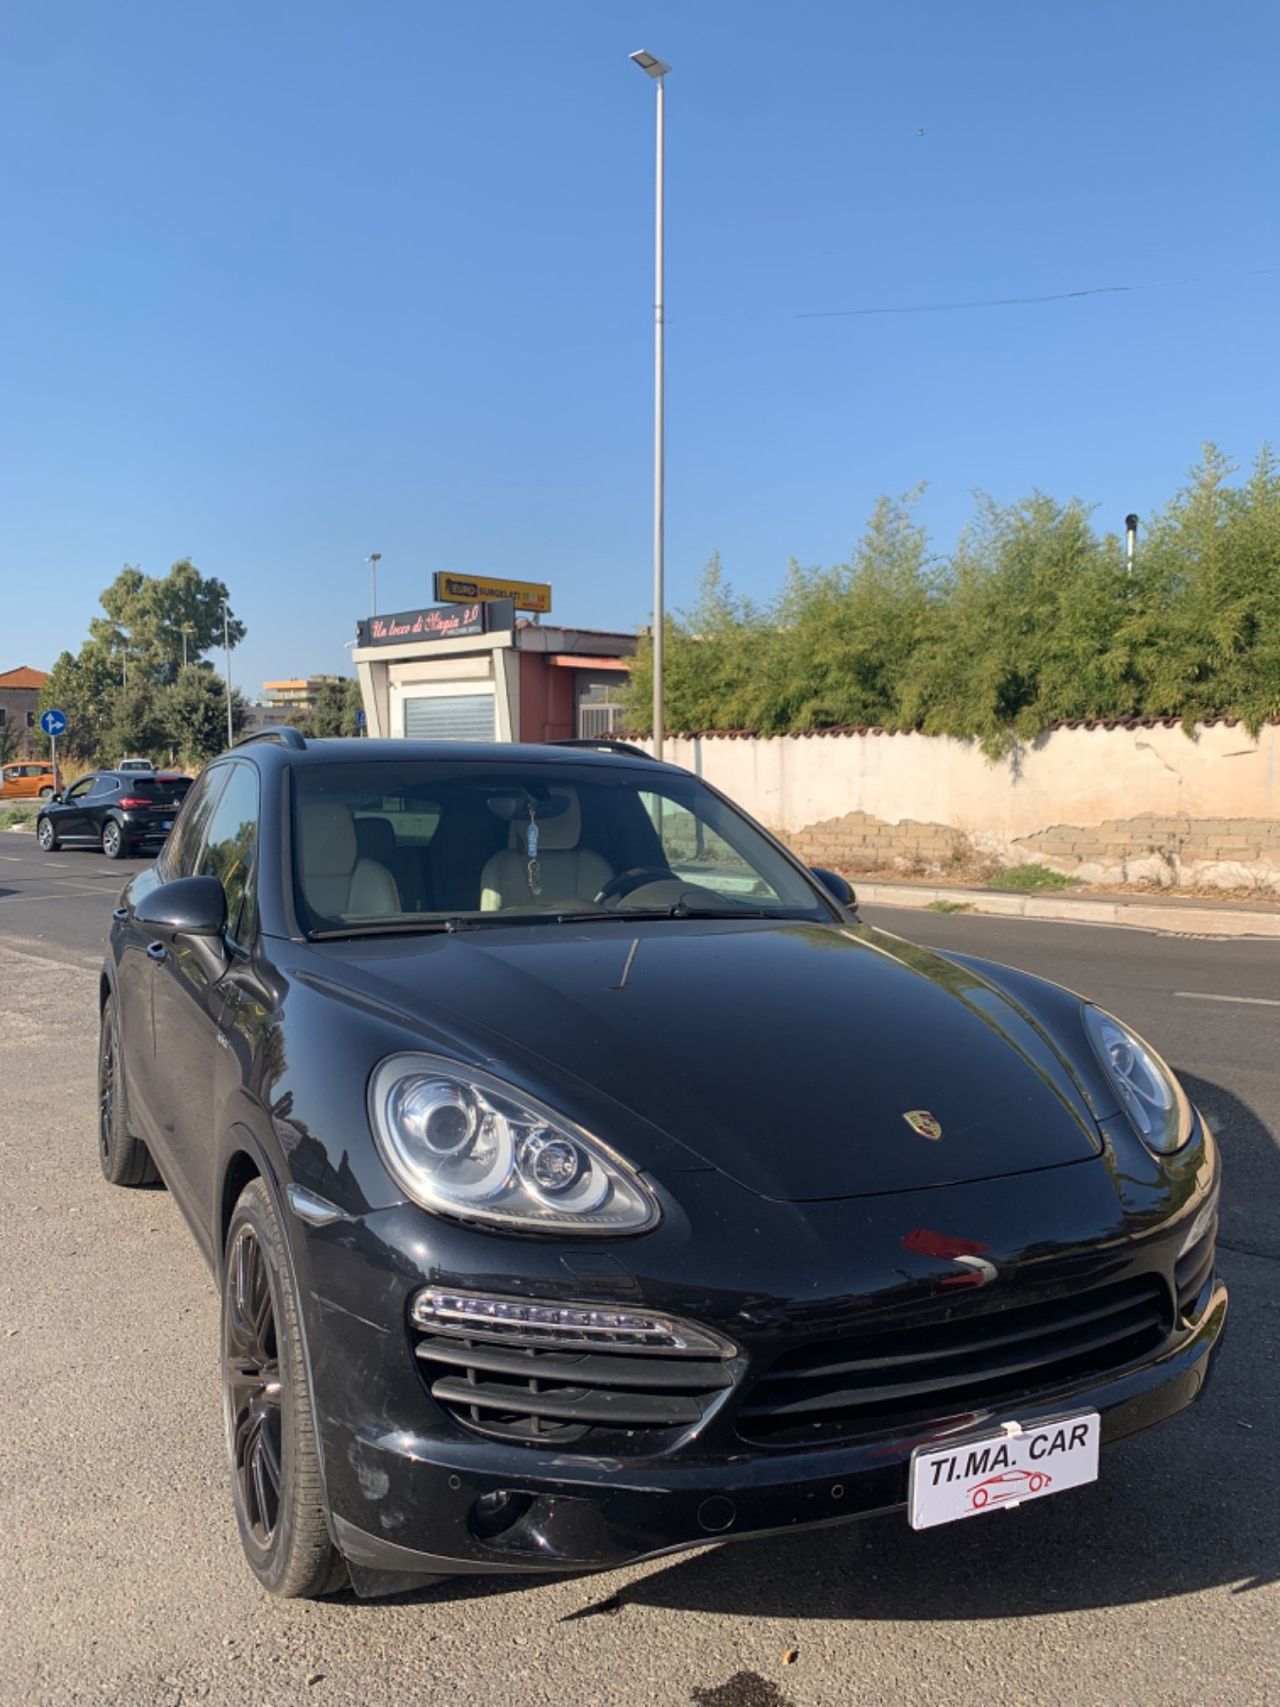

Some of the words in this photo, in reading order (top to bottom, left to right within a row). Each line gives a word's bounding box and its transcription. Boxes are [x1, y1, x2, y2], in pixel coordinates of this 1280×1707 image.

[412, 614, 424, 632] di
[930, 1444, 1017, 1486] TI.MA.
[1029, 1423, 1089, 1460] CAR
